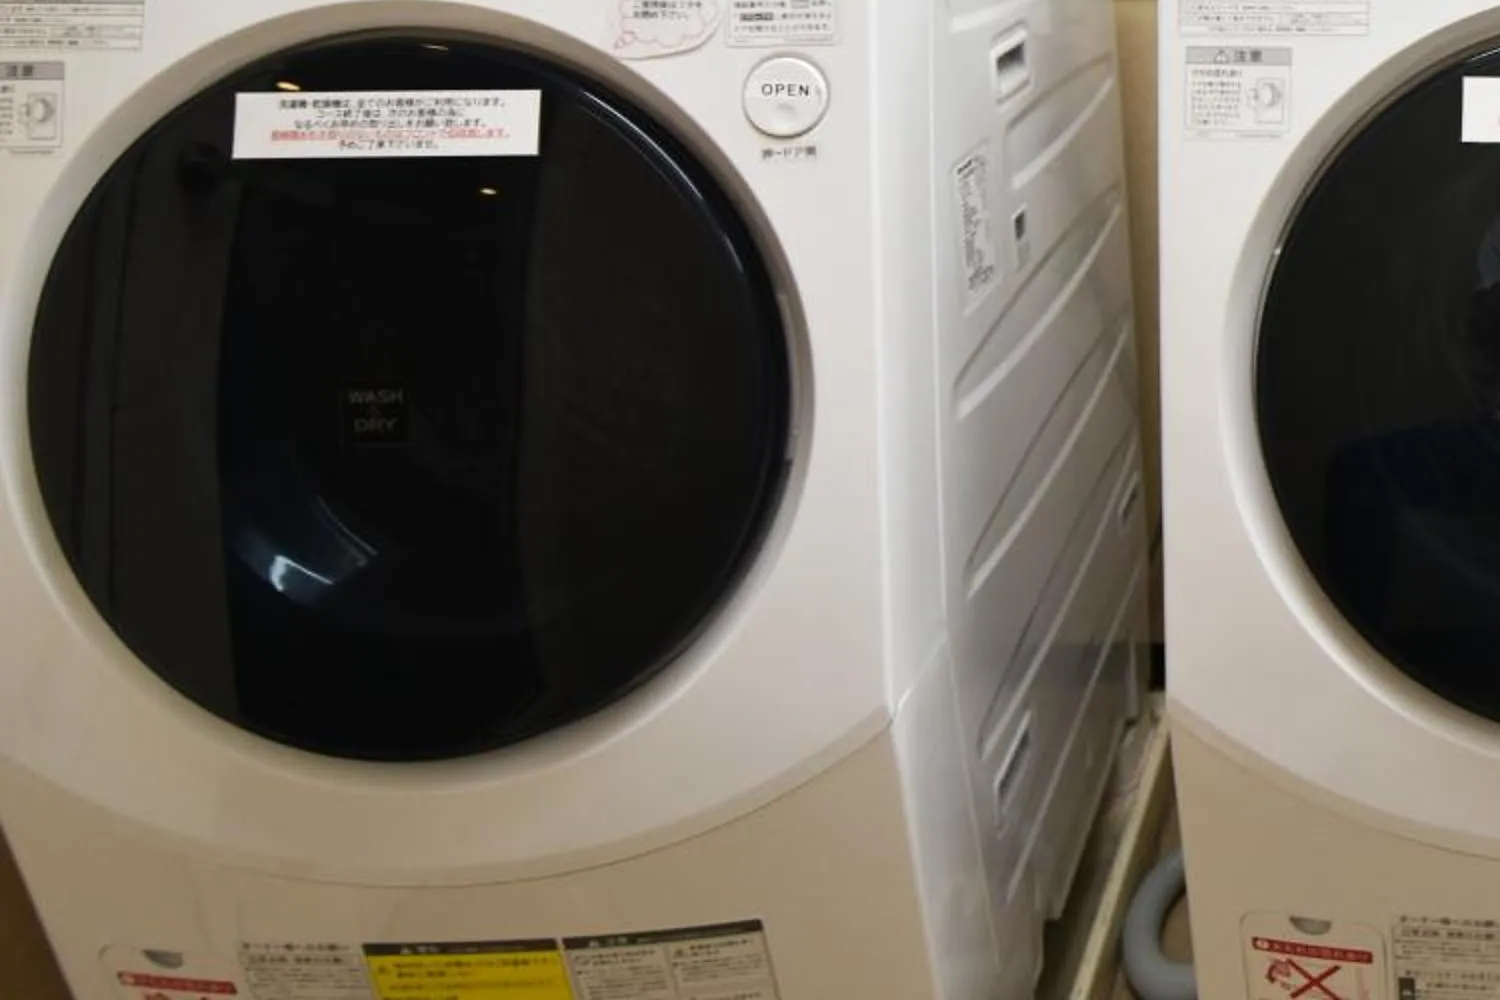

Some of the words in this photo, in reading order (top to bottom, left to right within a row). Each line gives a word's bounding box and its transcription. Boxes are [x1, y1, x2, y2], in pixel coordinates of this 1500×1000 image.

[1233, 49, 1263, 62] 注意
[761, 83, 810, 97] OPEN
[348, 388, 404, 404] WASH
[353, 417, 398, 434] DRY
